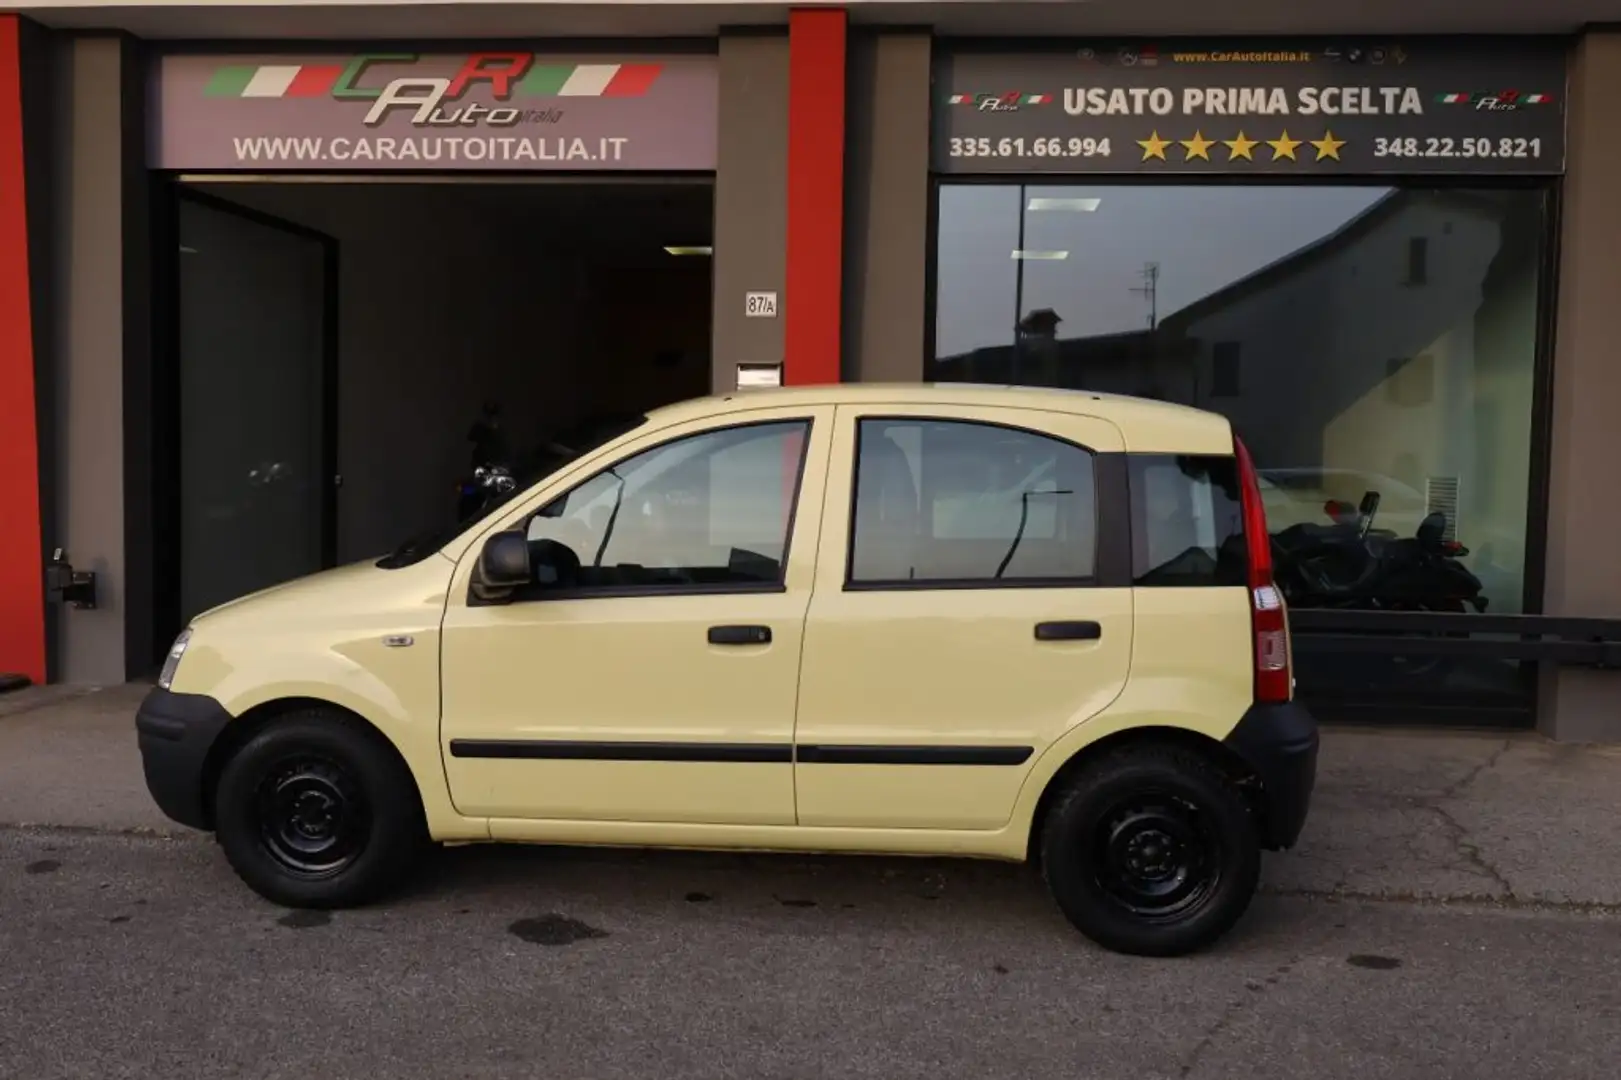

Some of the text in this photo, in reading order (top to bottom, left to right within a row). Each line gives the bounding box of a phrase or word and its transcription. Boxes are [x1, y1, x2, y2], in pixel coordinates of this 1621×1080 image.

[1063, 87, 1423, 115] USATO PRIMA SCELTA
[233, 137, 628, 162] WWW.CARAUTOITALIA.IT
[949, 137, 1111, 157] 335.61.66.994
[1374, 137, 1541, 157] 348.22.50.821
[748, 296, 774, 313] 87/A
